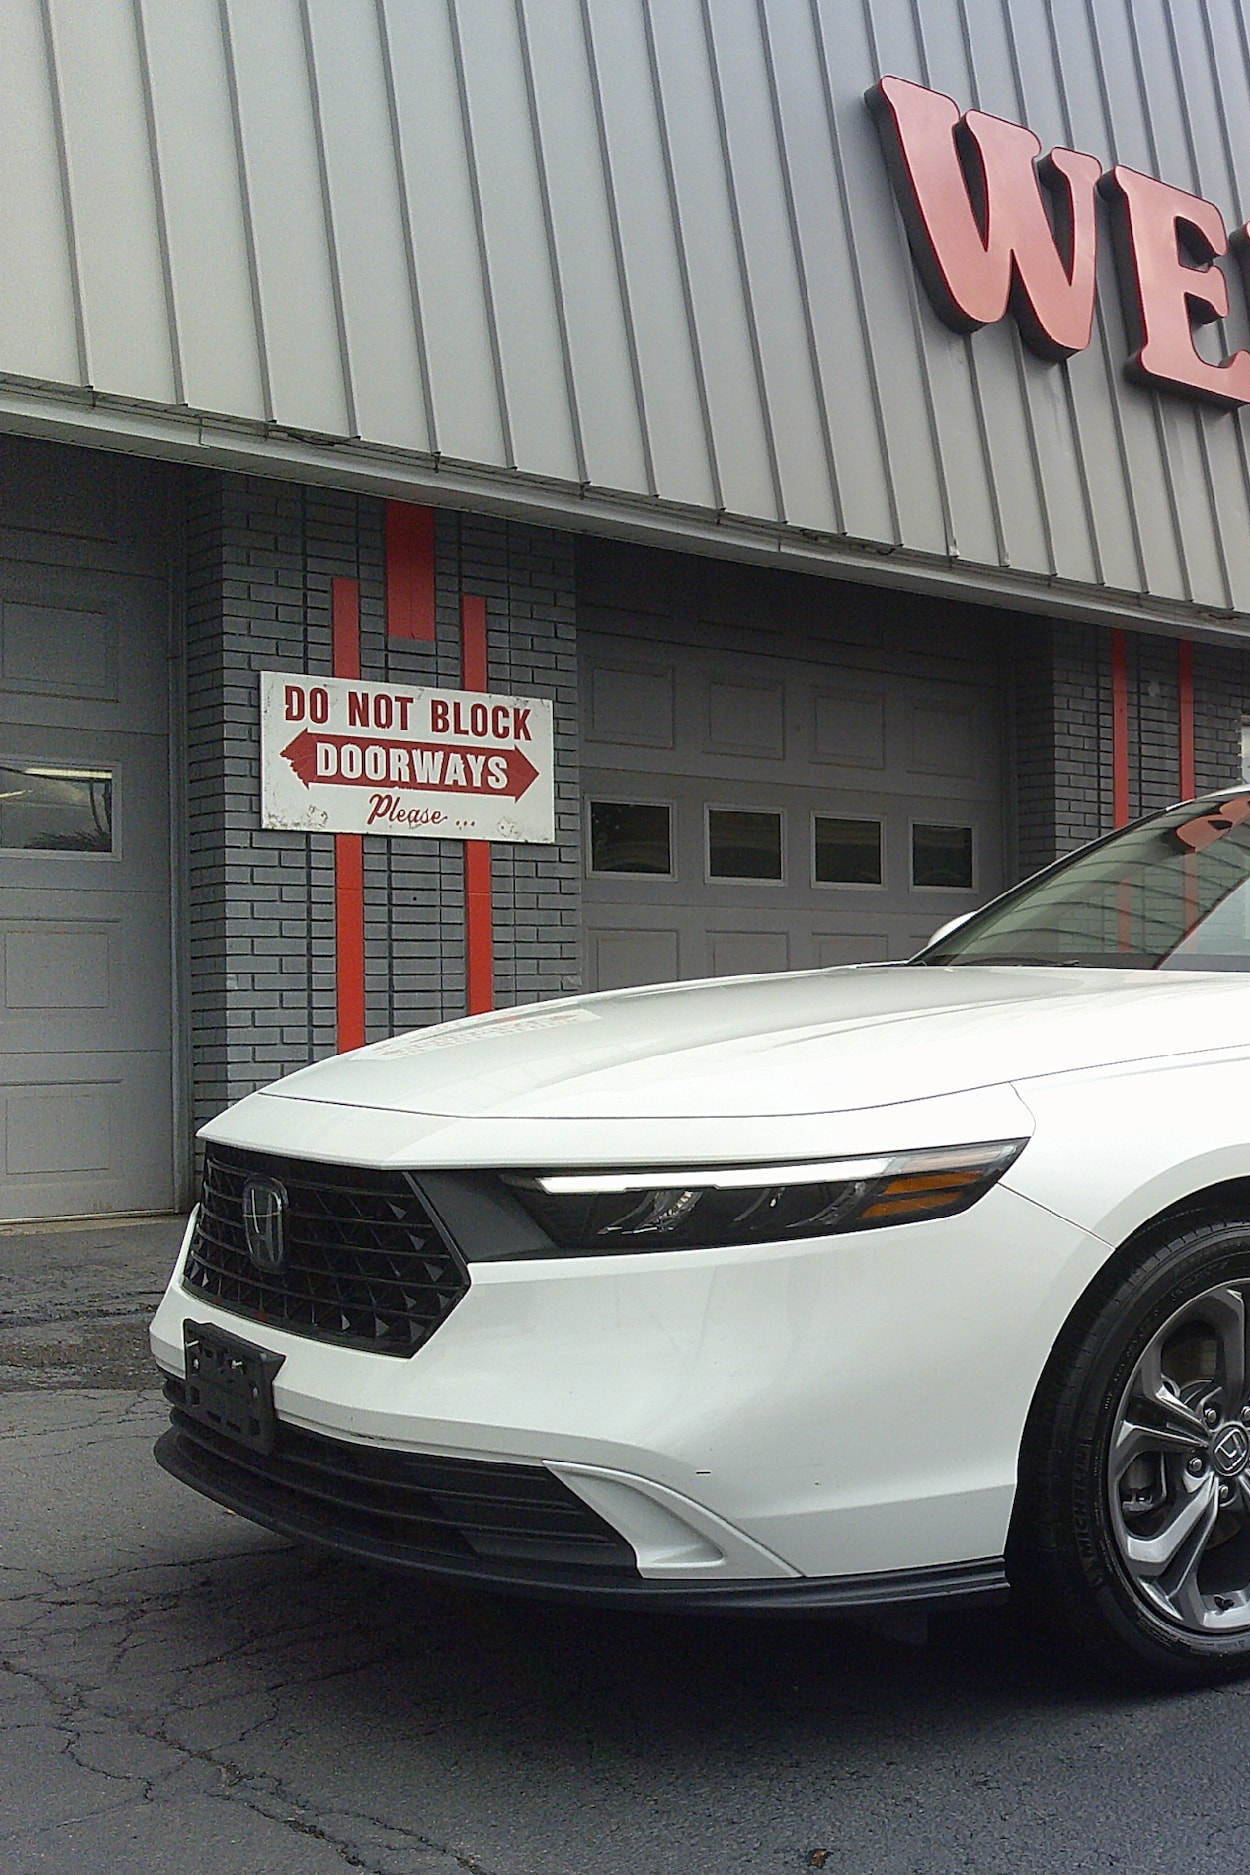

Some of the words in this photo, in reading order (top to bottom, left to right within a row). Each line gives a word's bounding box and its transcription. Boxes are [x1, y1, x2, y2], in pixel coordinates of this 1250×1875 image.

[284, 684, 329, 724] DO
[348, 690, 414, 731] NOT
[431, 699, 532, 742] BLOCK
[315, 741, 508, 790] DOORWAYS
[366, 793, 449, 826] Please
